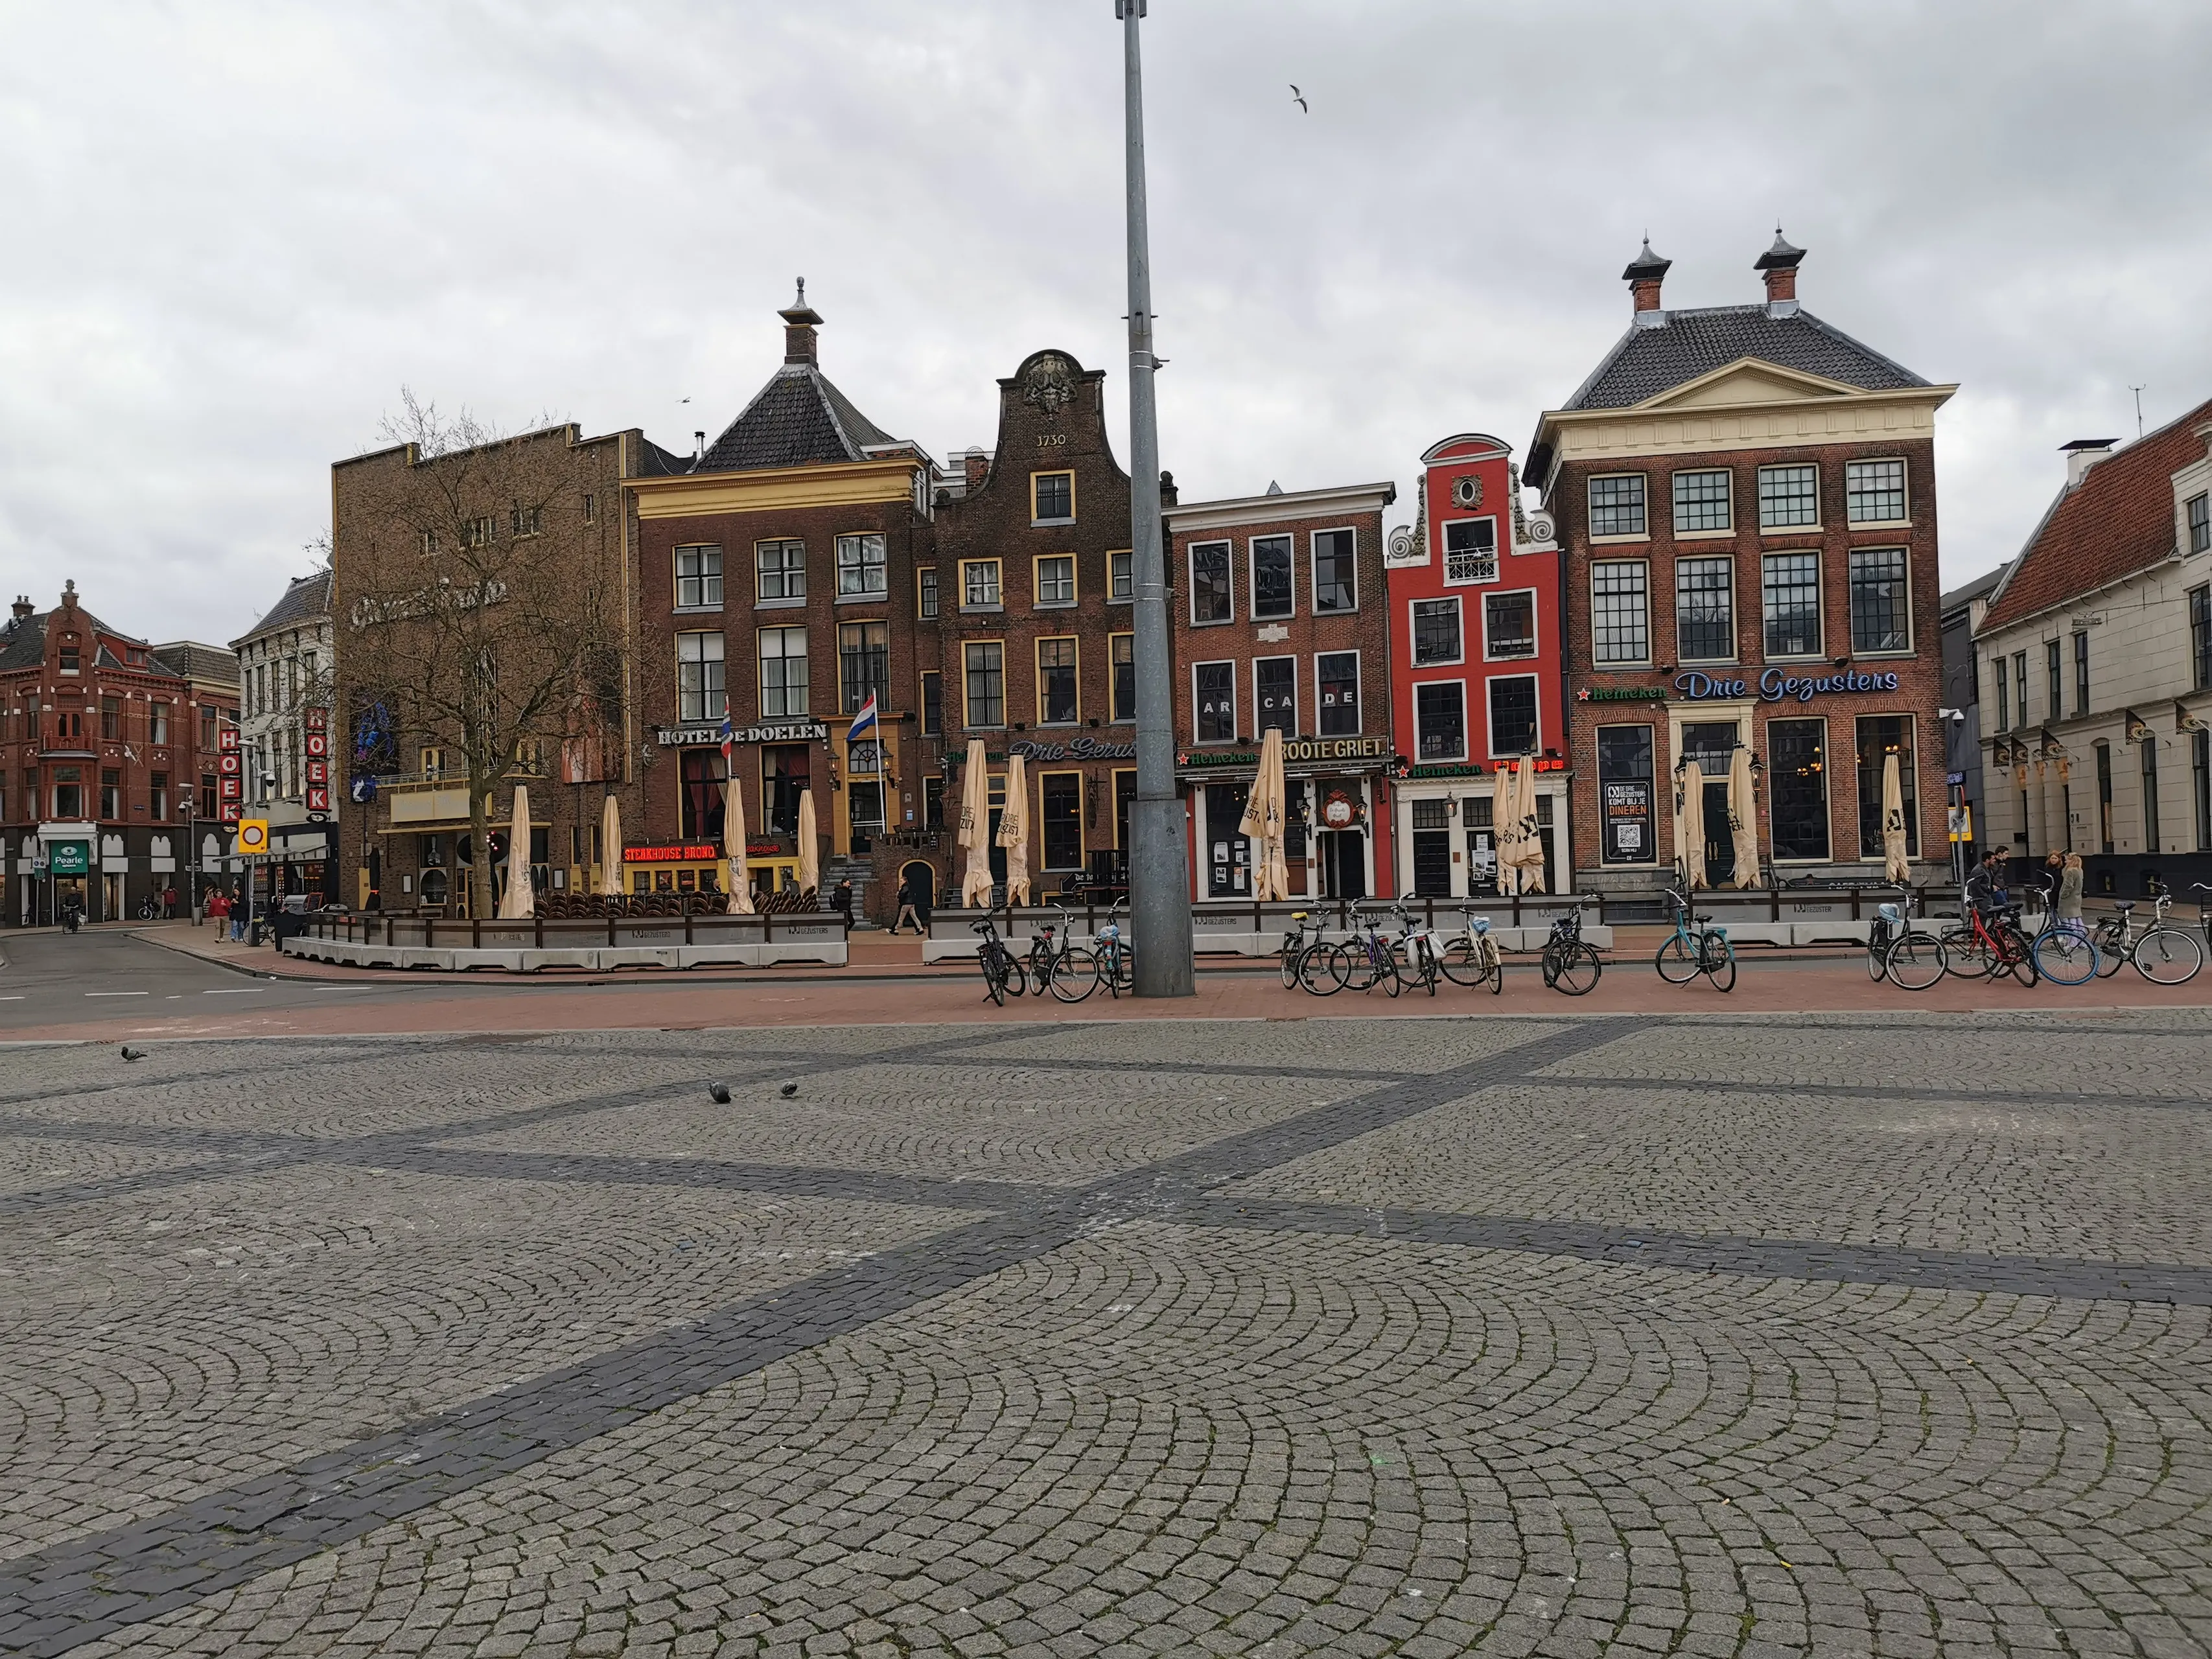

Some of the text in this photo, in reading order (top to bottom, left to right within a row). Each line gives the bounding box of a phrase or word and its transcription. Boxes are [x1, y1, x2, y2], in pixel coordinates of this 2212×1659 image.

[1037, 434, 1065, 447] 1730
[1675, 667, 1898, 702] Drie Gezusters
[1592, 685, 1667, 701] Heineken
[658, 729, 722, 745] HOTEL
[748, 725, 827, 741] DOELEN
[1008, 737, 1137, 761] Drie Gezus
[1334, 739, 1380, 758] GRIET
[308, 710, 325, 807] HOEK
[948, 752, 1004, 762] Heien
[1191, 752, 1255, 765] Heineken
[1413, 763, 1480, 778] Heineken
[1494, 760, 1563, 772] Hope
[222, 732, 238, 820] HOEK
[1609, 805, 1647, 815] DINEREN
[624, 846, 681, 861] STEAKHOUSE
[746, 844, 780, 853] eakhouse
[55, 856, 84, 864] Pearle
